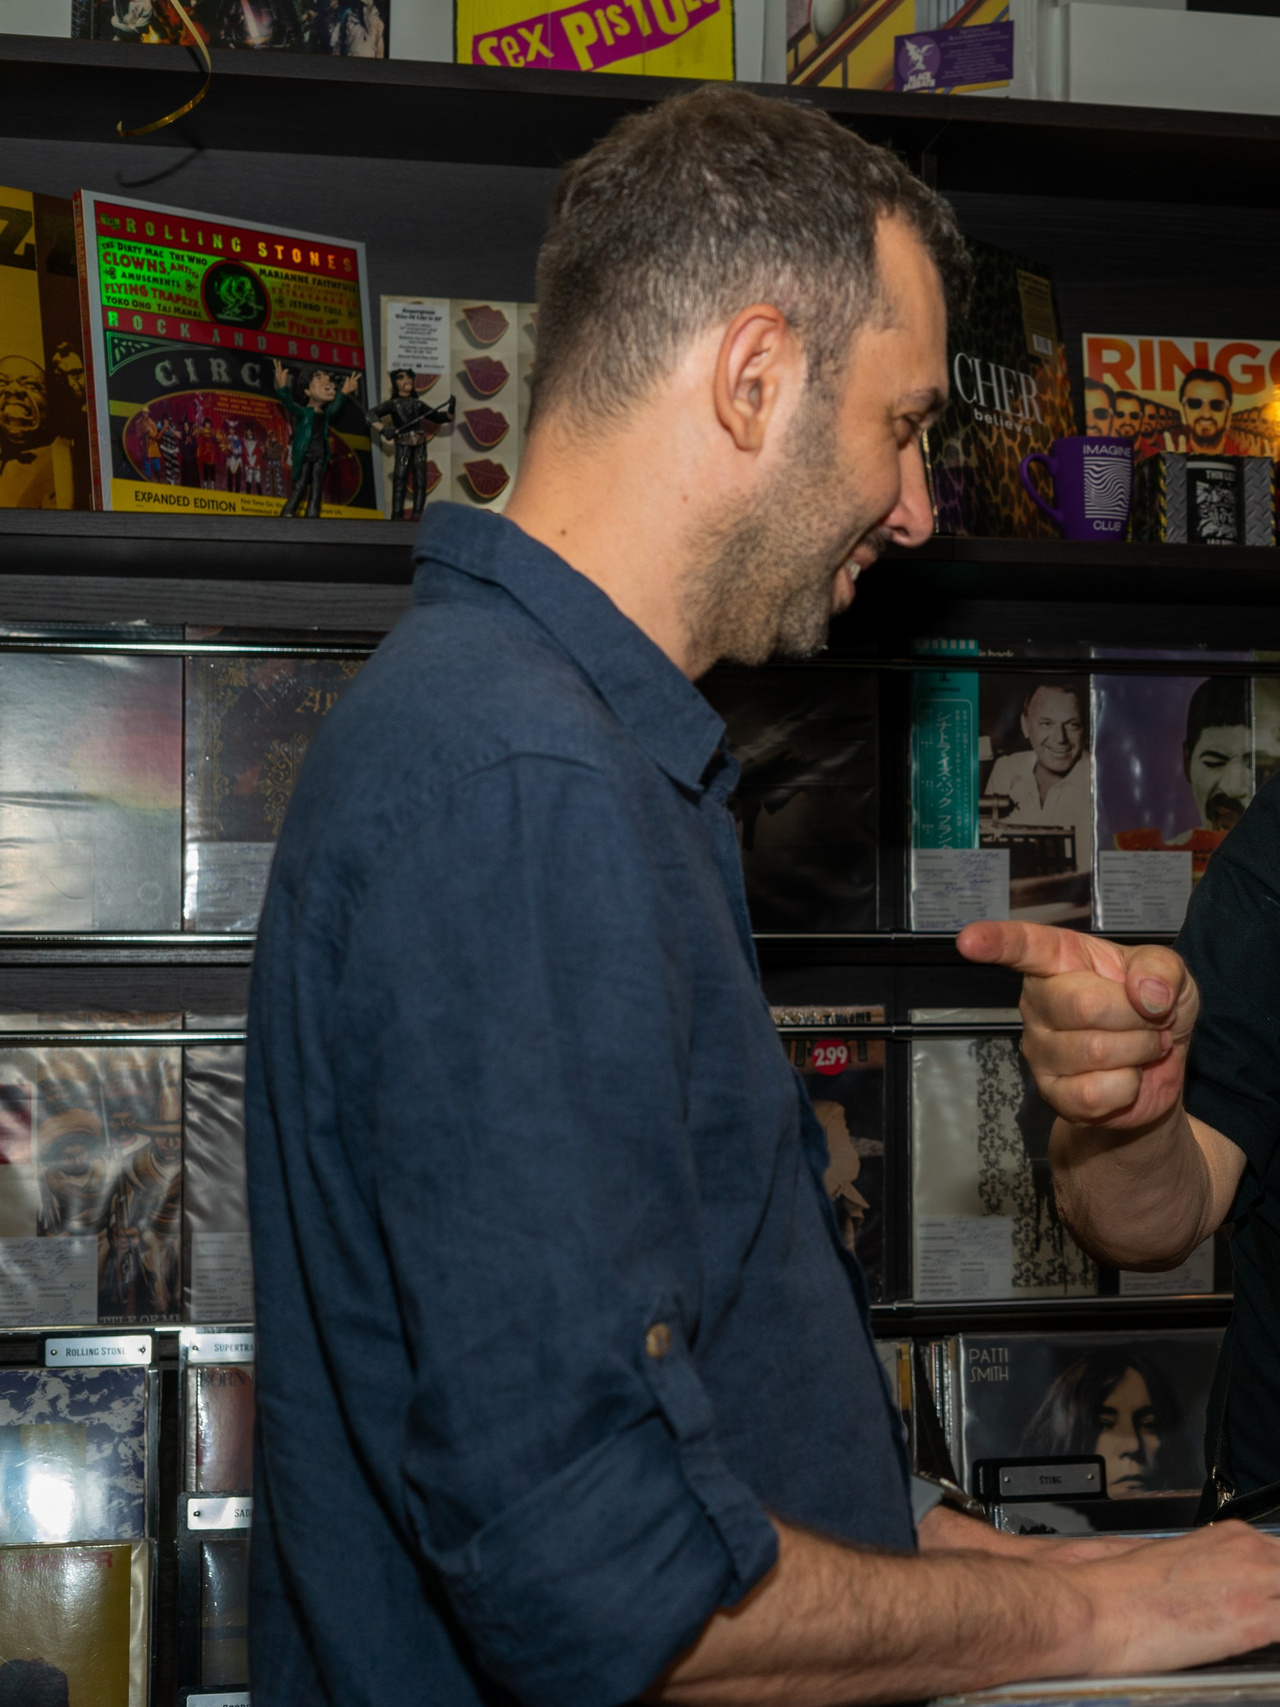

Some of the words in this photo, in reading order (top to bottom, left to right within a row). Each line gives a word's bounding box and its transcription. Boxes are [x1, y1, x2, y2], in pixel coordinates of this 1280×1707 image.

[117, 242, 143, 256] DIRTY
[145, 247, 165, 259] MAC
[125, 216, 243, 253] ROLLING
[256, 241, 354, 273] STONES
[120, 271, 181, 289] AMUSEMENTS
[259, 267, 310, 286] MARIANNE
[104, 282, 149, 299] FLYING
[105, 295, 131, 307] YOKO
[288, 299, 321, 314] JETHRO
[323, 304, 343, 317] TULL
[106, 310, 193, 337] ROCK
[211, 324, 269, 351] AND
[287, 340, 364, 368] ROLL
[153, 356, 262, 388] CIRC
[953, 351, 1044, 425] CHER
[973, 407, 1033, 436] believe
[1082, 444, 1132, 459] IMAGINE
[134, 489, 191, 508] EXPANDED
[193, 497, 237, 513] EDITION
[1092, 519, 1122, 534] CLUB
[65, 1347, 100, 1358] ROLLING
[213, 1343, 254, 1353] SUPERTRA
[968, 1347, 1010, 1365] PATTI
[968, 1365, 1010, 1383] SMITH
[1038, 1474, 1063, 1486] STING
